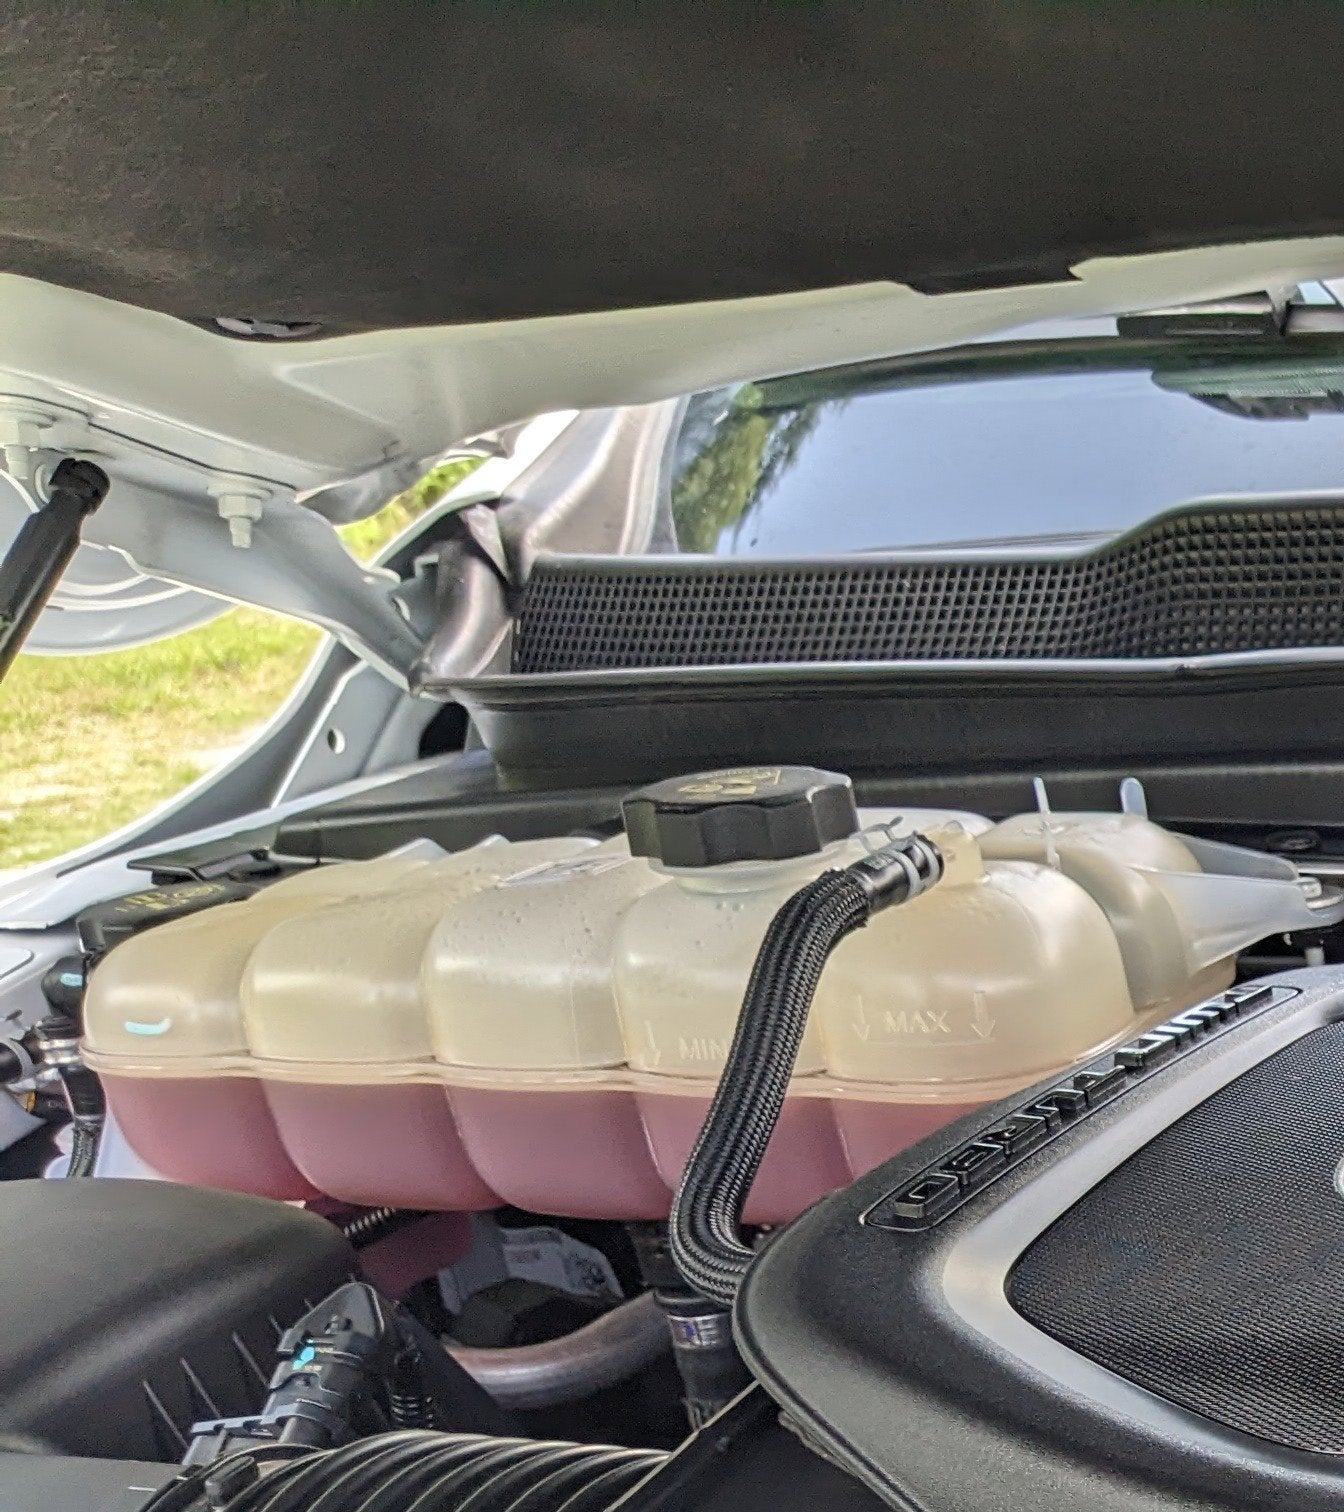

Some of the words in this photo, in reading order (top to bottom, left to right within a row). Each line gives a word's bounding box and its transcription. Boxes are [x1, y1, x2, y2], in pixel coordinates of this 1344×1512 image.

[679, 1037, 729, 1060] MIN
[884, 1010, 951, 1034] MAX
[1114, 984, 1273, 1068] TWIN
[894, 1065, 1127, 1218] TURBO
